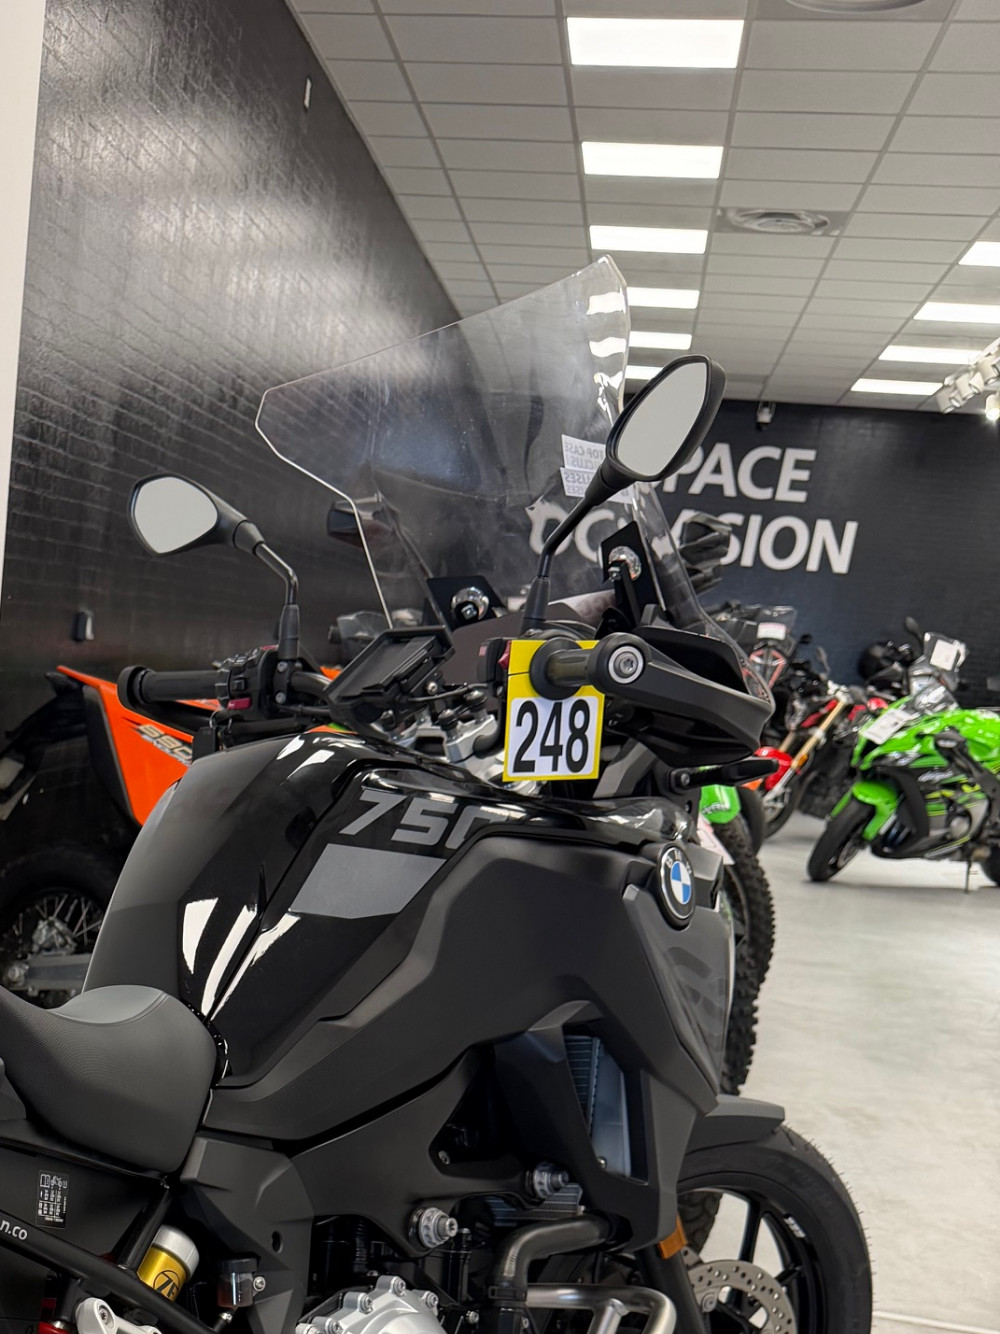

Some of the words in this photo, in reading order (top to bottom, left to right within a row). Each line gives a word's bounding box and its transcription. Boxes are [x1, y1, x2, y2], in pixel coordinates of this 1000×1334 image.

[655, 443, 817, 503] PACE
[525, 502, 858, 574] OCSION
[512, 698, 590, 774] 248
